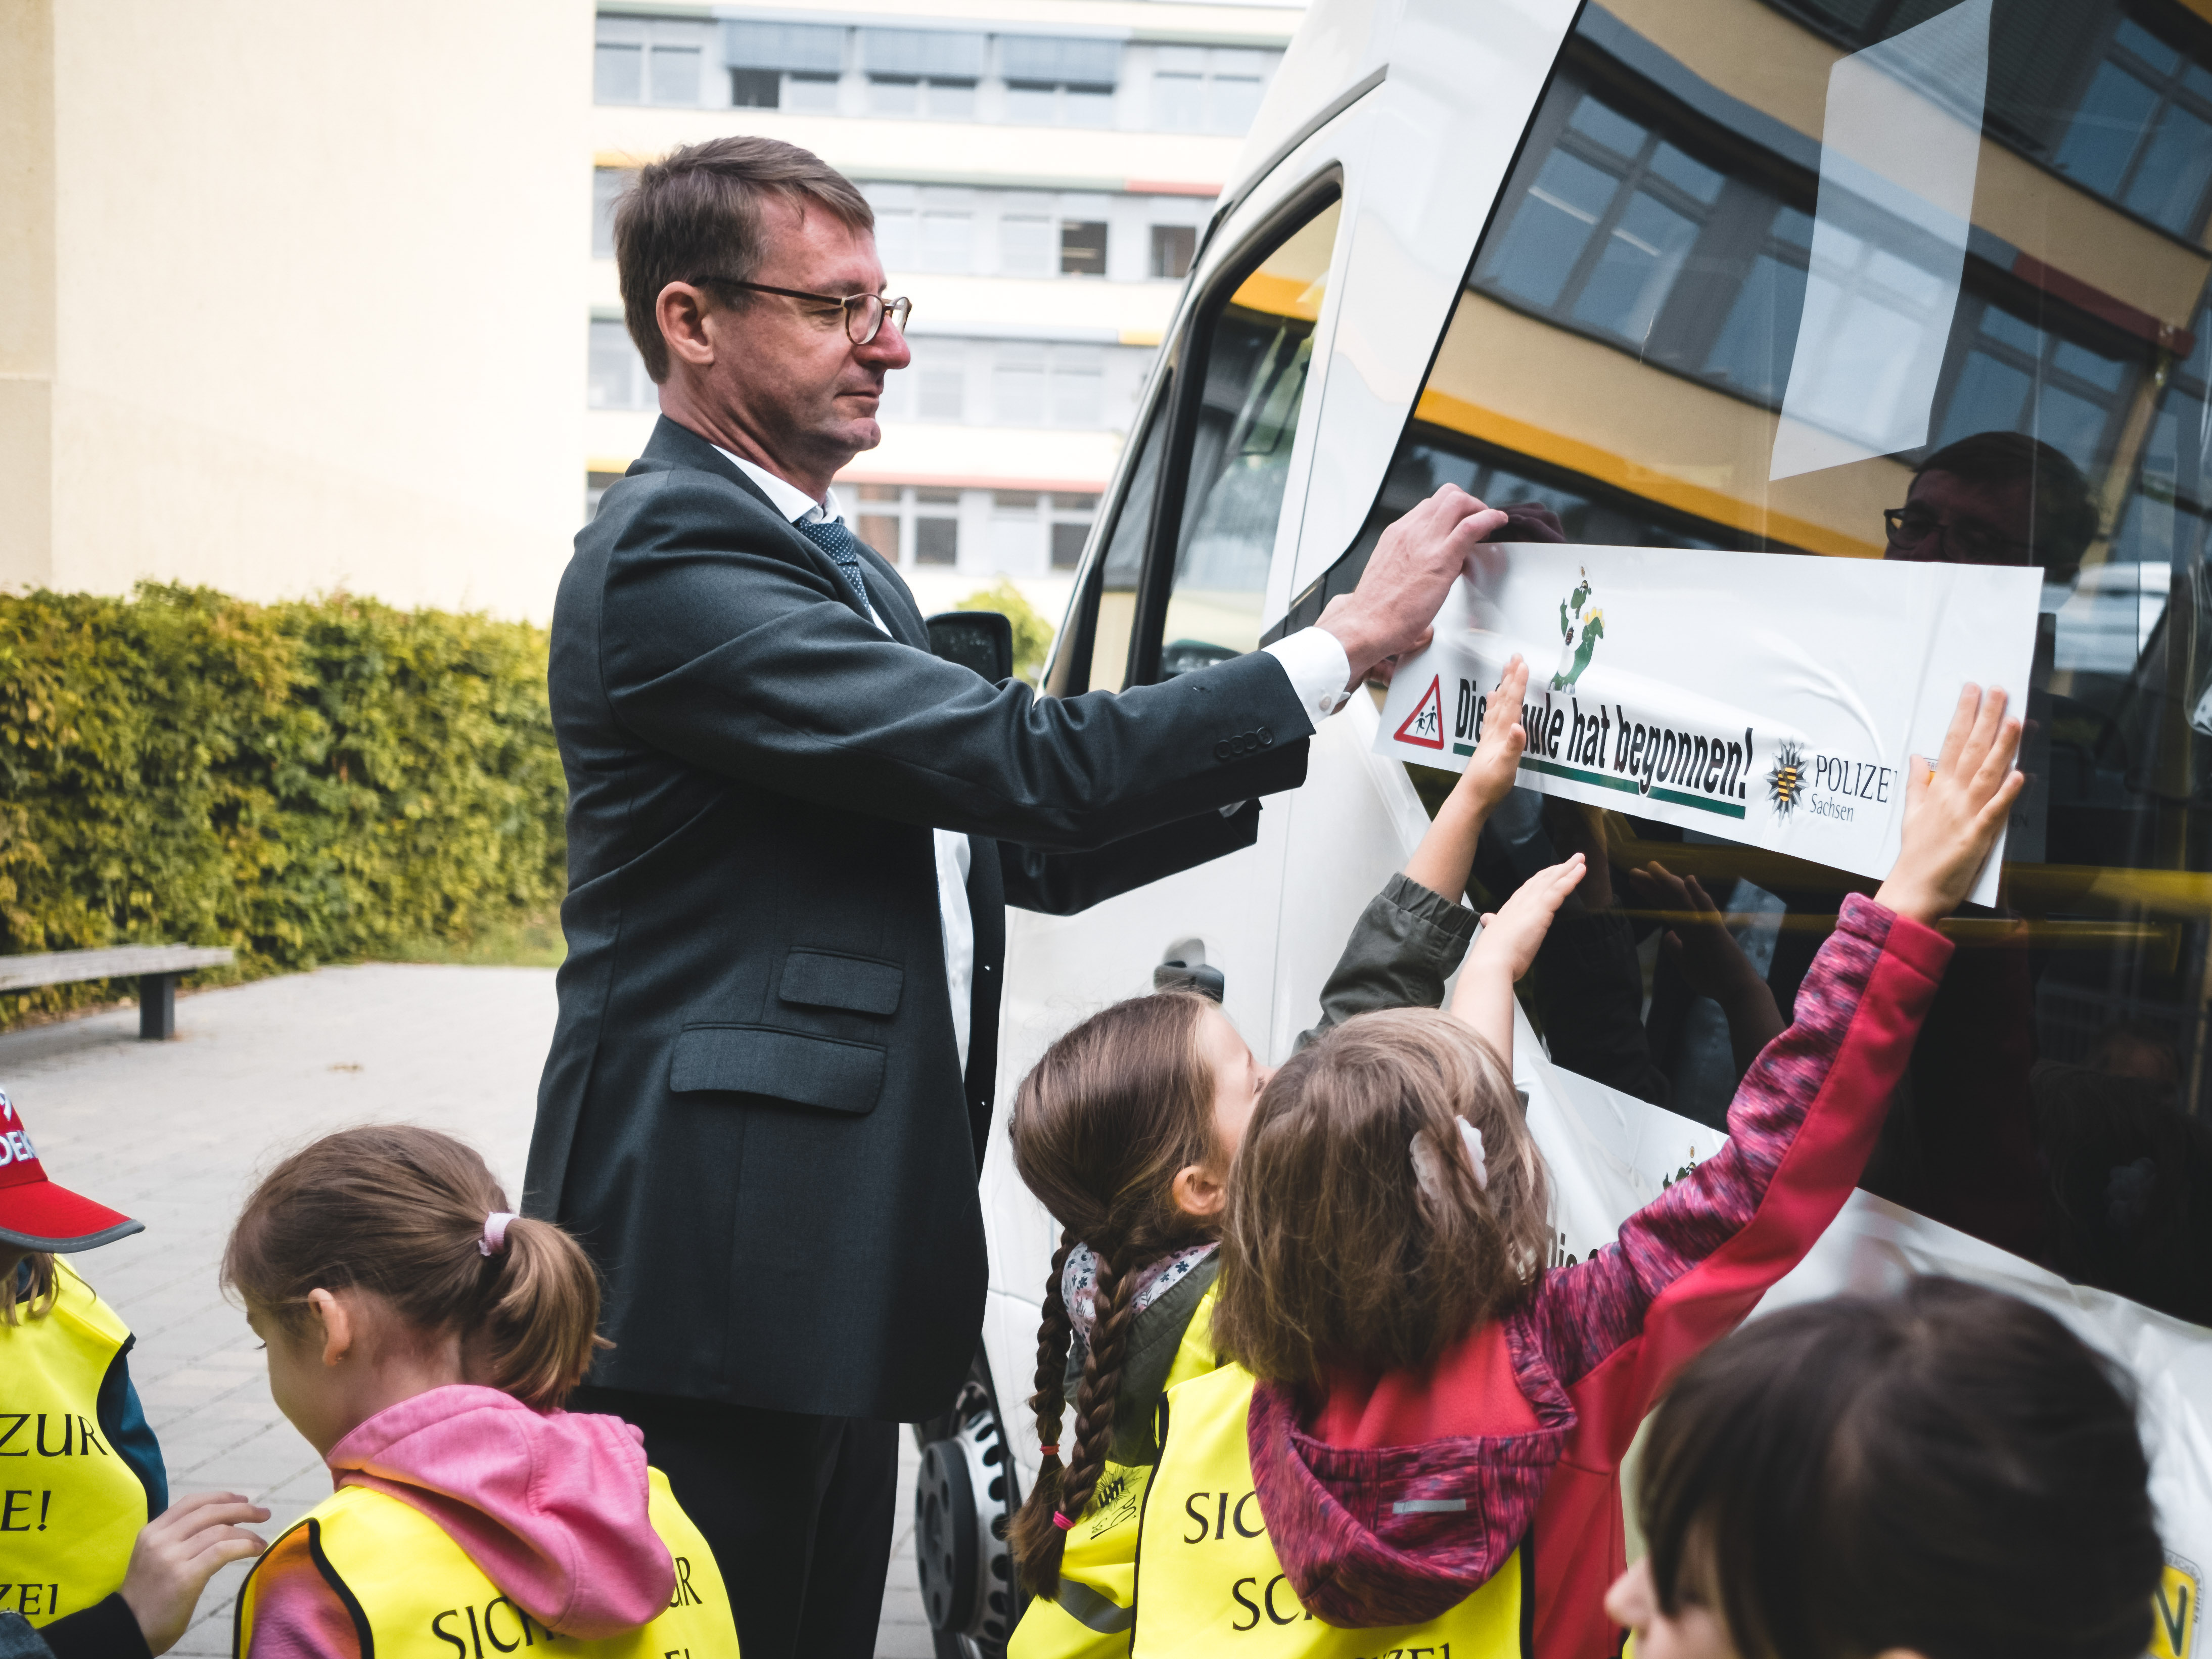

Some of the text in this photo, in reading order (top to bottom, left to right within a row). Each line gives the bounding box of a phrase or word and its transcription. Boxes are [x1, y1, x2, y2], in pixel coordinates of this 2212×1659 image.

[1455, 678, 1754, 799] Die ule hat begonnen!
[1810, 793, 1854, 823] Sachsen
[0, 1413, 108, 1457] ZUR
[1184, 1491, 1266, 1544] SIC
